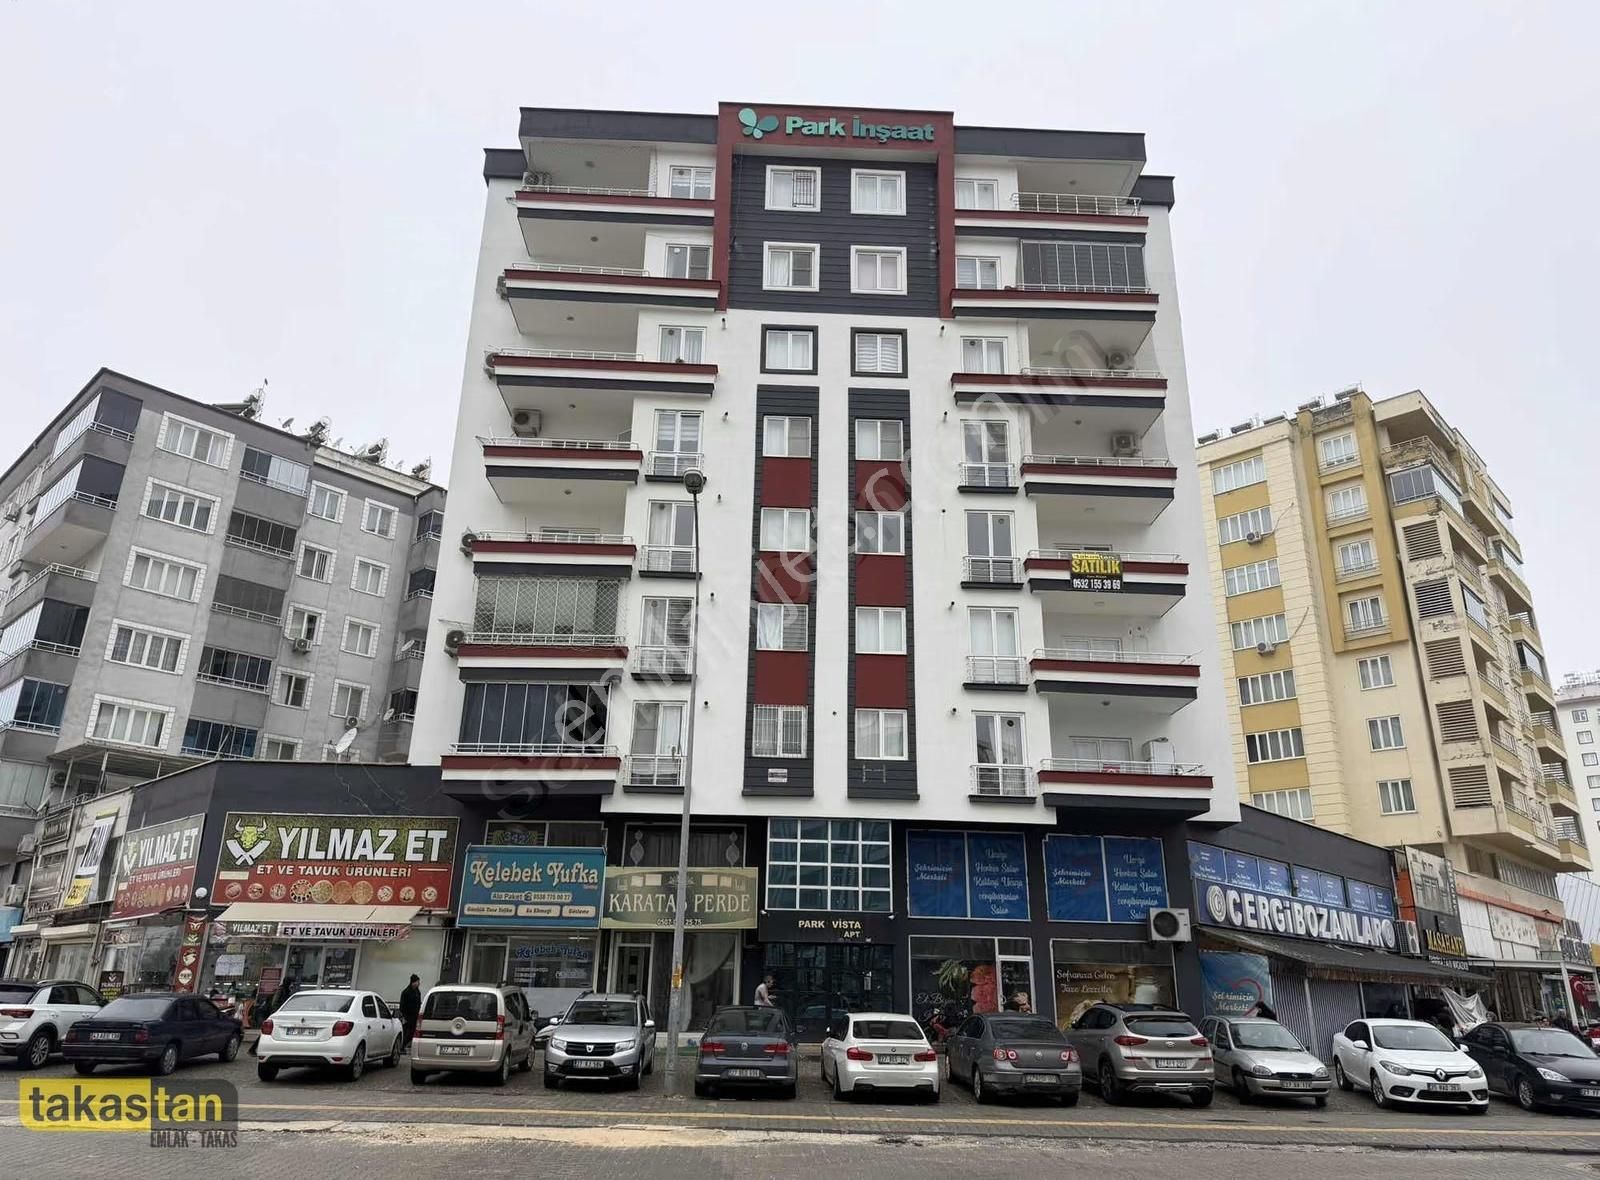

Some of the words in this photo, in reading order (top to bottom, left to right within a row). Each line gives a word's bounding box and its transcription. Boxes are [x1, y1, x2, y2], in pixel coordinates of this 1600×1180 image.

[785, 116, 846, 137] Park
[852, 115, 935, 143] İnşaat
[1072, 559, 1120, 574] SATILIK
[1073, 578, 1089, 589] 0532
[1091, 579, 1102, 589] 155
[138, 831, 181, 868] YILMAZ
[179, 827, 199, 860] ET
[277, 827, 398, 862] YILMAZ
[404, 829, 449, 862] ET
[256, 866, 272, 875] ET
[277, 866, 294, 875] VE
[298, 866, 341, 877] TAVUK
[345, 864, 412, 878] ÜRÜNLERİ
[470, 861, 543, 888] Kelebek
[546, 862, 599, 888] Yufka
[608, 893, 688, 913] KARATA
[694, 894, 751, 913] PERDE
[232, 923, 260, 934] YILMAZ
[260, 924, 272, 934] ET
[283, 926, 296, 936] ET
[299, 926, 312, 936] VE
[314, 926, 346, 936] TAVUK
[798, 920, 825, 929] PARK
[832, 918, 862, 929] VİSTA
